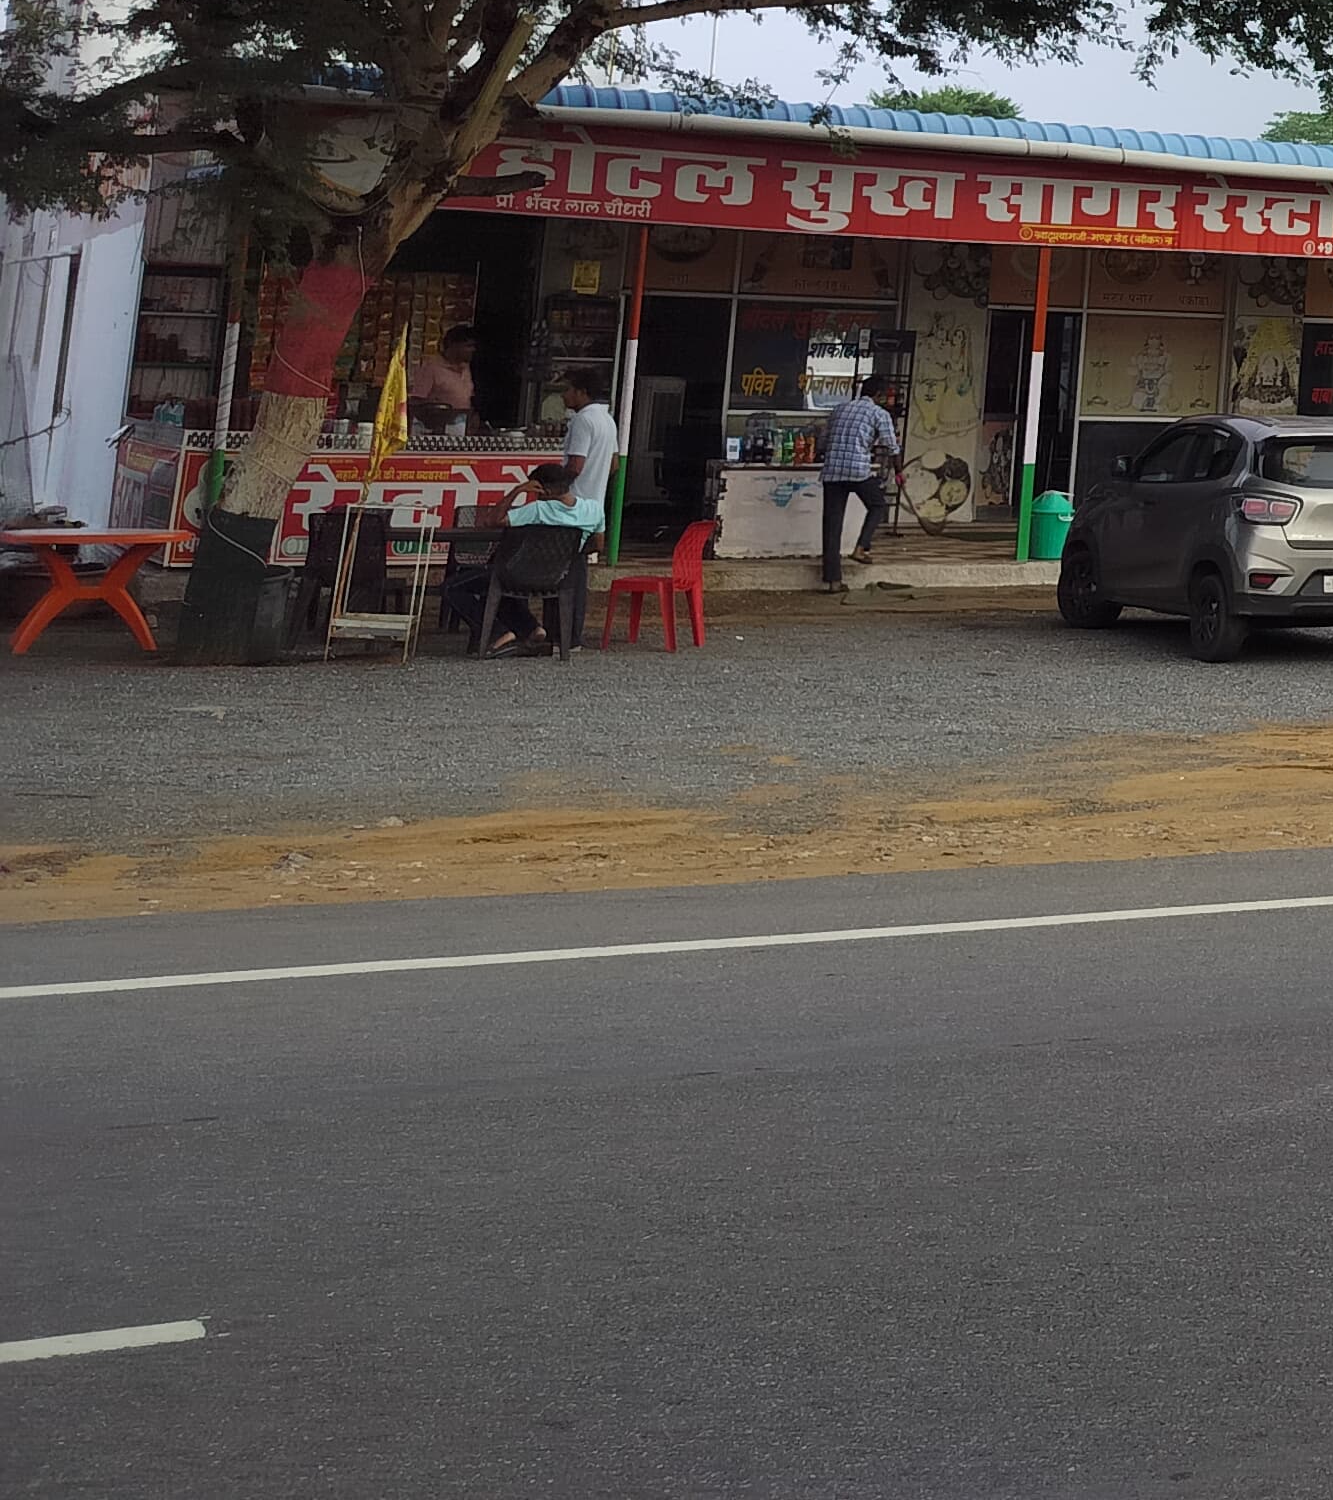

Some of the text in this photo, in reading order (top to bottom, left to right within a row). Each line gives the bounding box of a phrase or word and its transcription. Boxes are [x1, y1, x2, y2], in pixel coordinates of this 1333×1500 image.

[564, 199, 600, 214] लाल
[604, 198, 652, 218] चौधरी
[781, 160, 966, 232] सुख
[977, 174, 1182, 230] सागर
[741, 367, 779, 397] पवित्र
